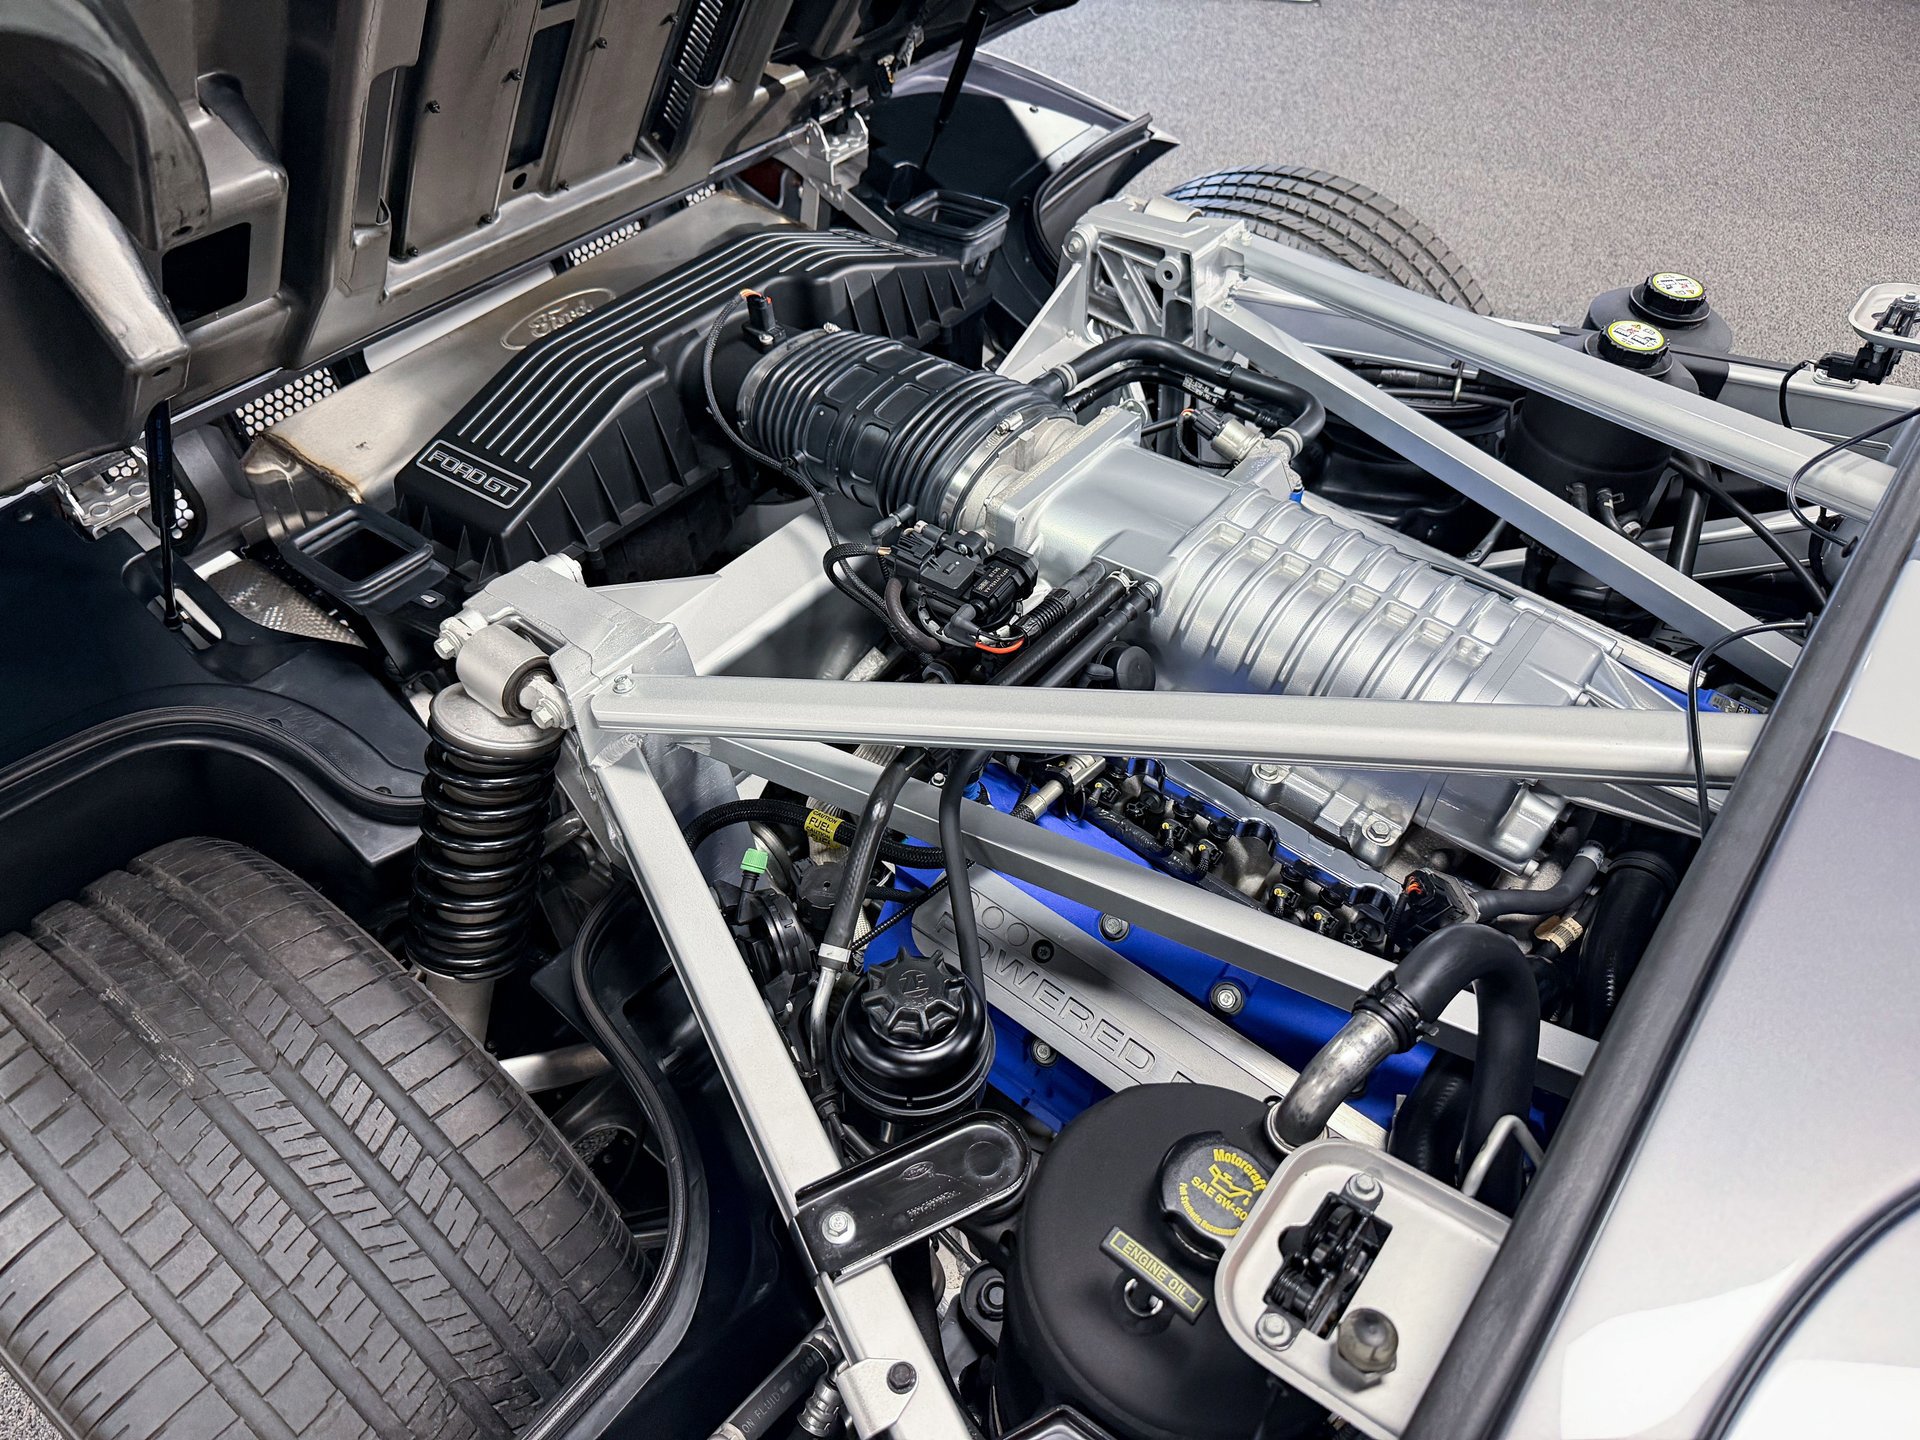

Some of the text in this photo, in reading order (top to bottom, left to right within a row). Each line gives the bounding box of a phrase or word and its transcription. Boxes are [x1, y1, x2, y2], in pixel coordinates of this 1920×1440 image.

[427, 449, 519, 498] FORD GT
[805, 825, 831, 839] CAUTION
[808, 816, 832, 834] FUEL
[812, 810, 838, 824] CAUTION
[1213, 1148, 1267, 1192] Motorcraft
[1191, 1176, 1248, 1221] SAE 5W-50
[1122, 1240, 1189, 1300] ENGINE OIL
[754, 1391, 781, 1419] FLUID
